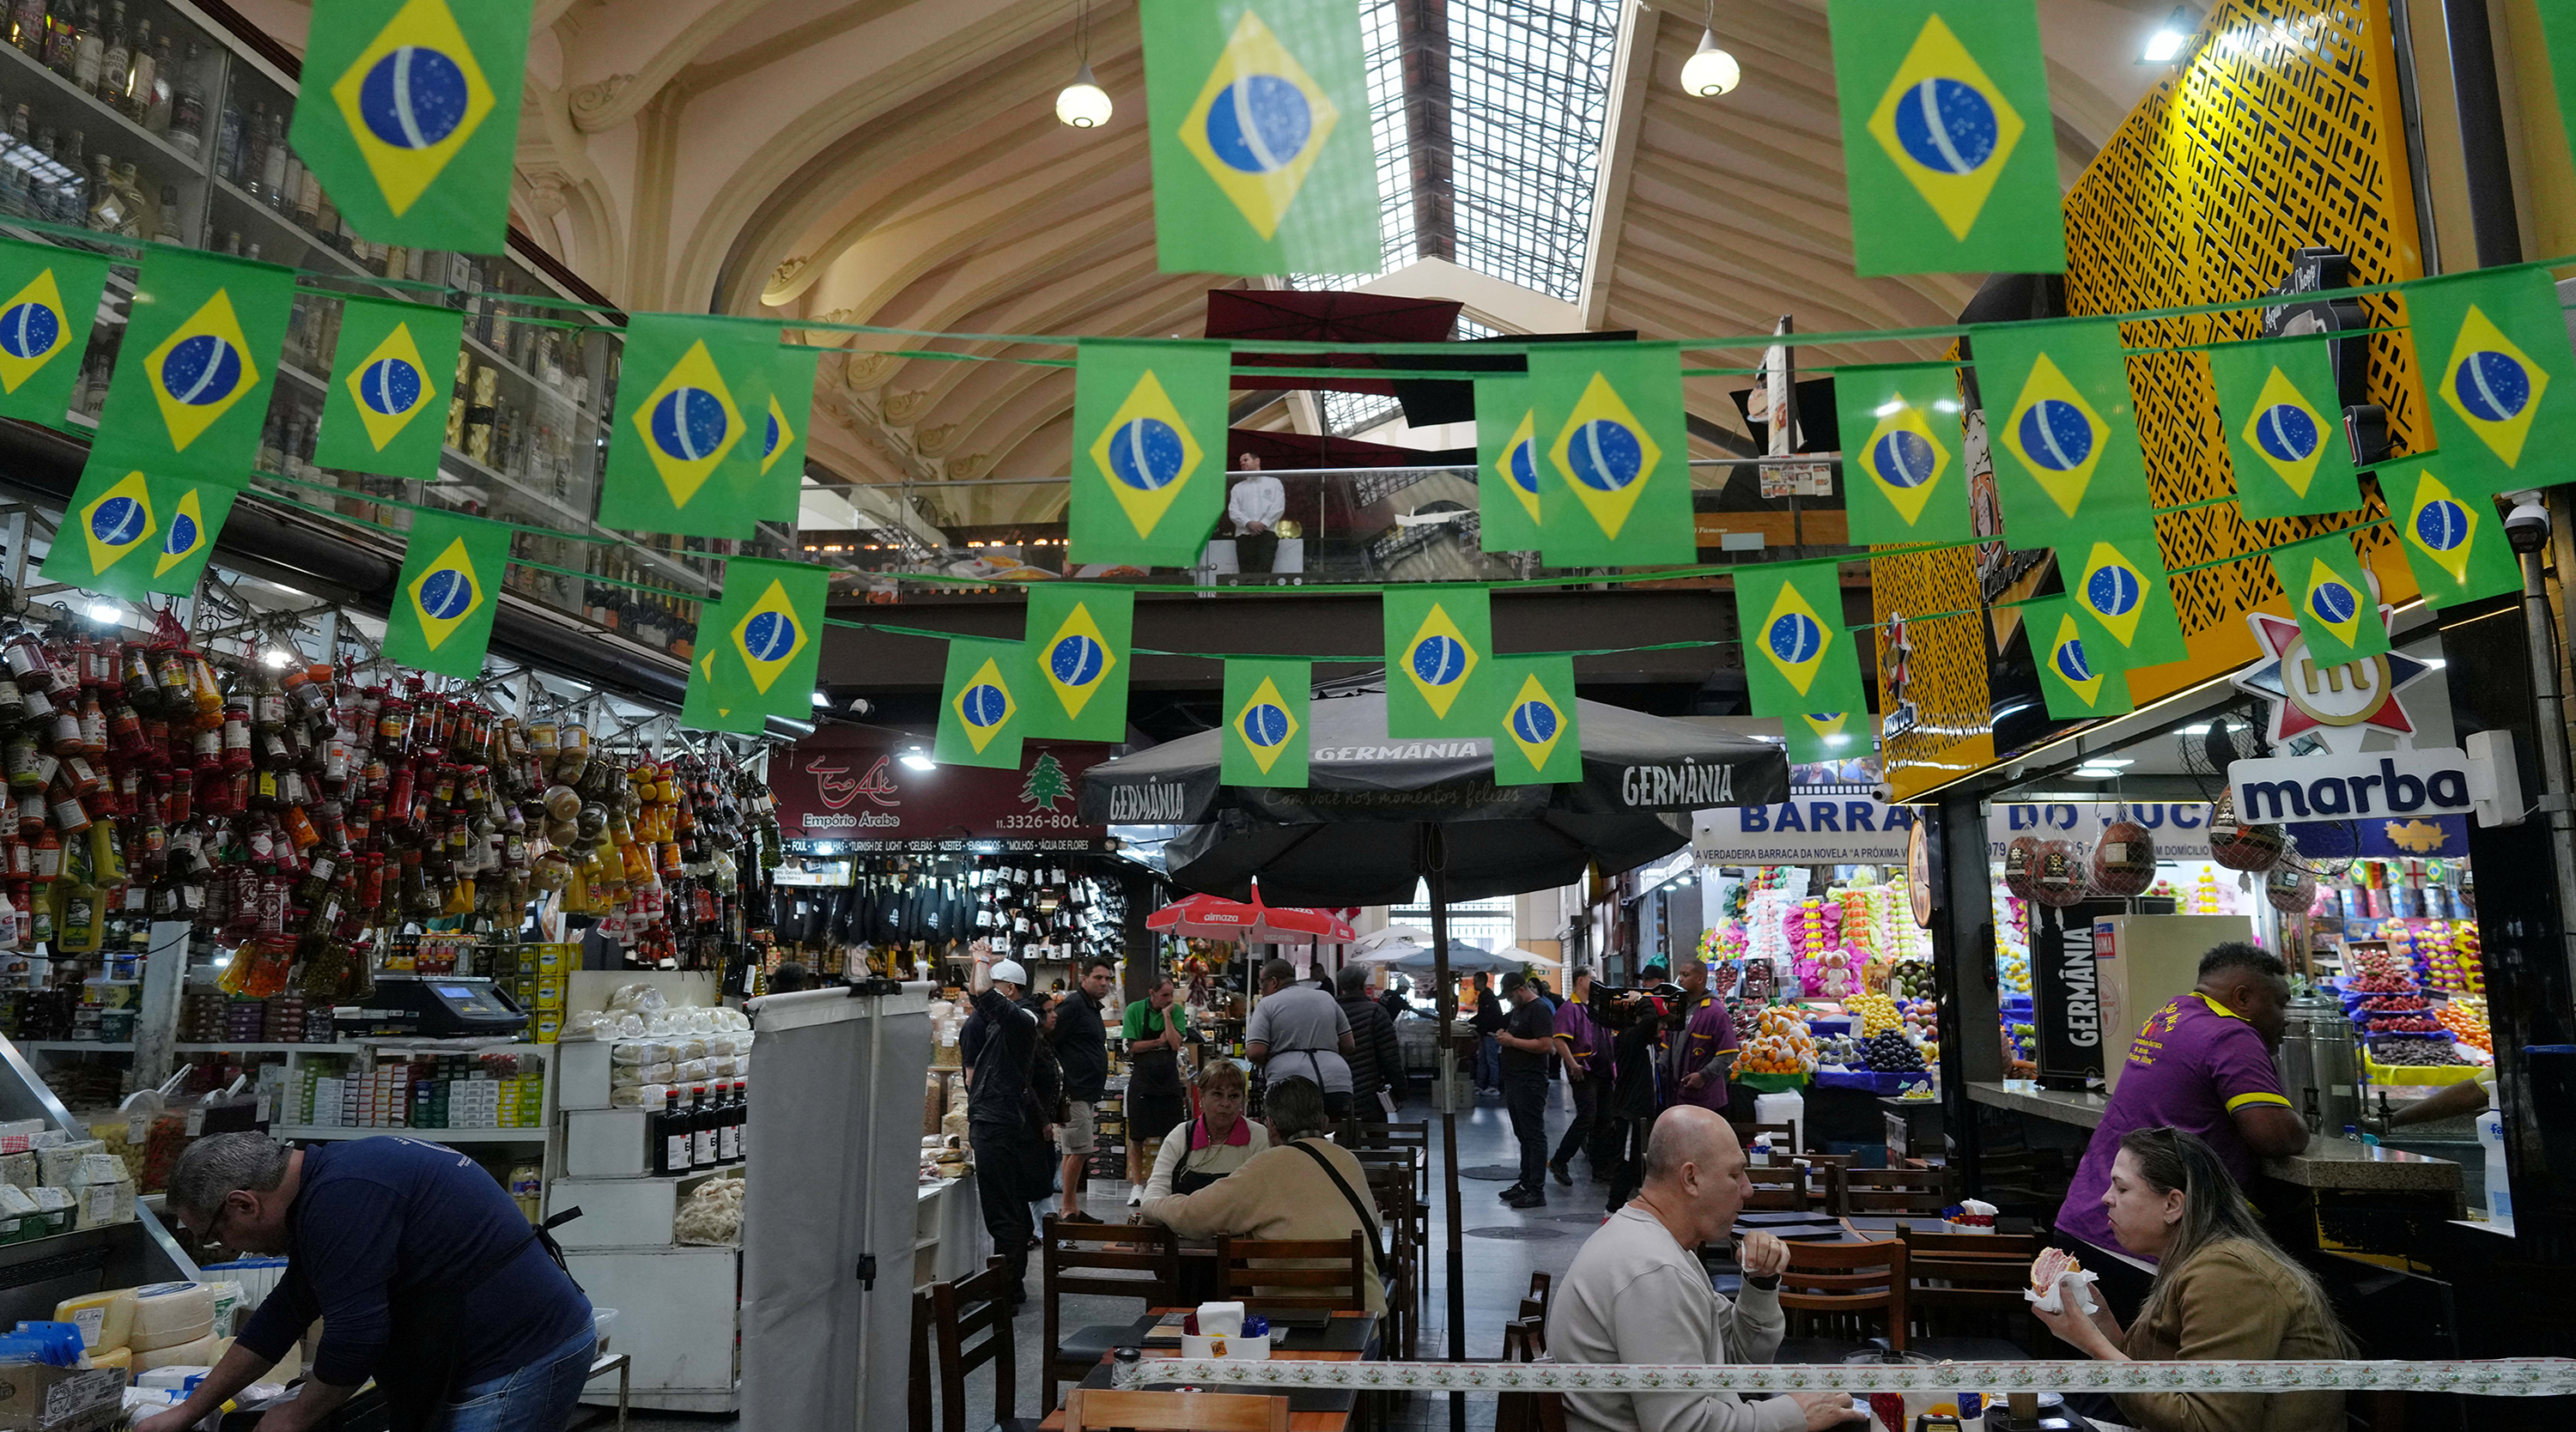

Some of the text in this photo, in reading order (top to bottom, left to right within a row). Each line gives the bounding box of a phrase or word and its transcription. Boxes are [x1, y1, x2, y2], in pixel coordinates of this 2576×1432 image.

[1315, 742, 1479, 761] GERMÂNIA
[1623, 756, 1735, 805] GERMÂNIA
[2243, 758, 2470, 820] marba
[1110, 775, 1184, 821] GERMÂNIA
[803, 810, 900, 828] Empório Árabe
[996, 815, 1090, 828] 11.3326-806
[1741, 801, 1925, 832] BARRA
[2102, 804, 2215, 830] JUC
[885, 841, 902, 851] LIGHT
[1067, 840, 1089, 850] FLORES
[1696, 850, 1701, 859] A
[1703, 849, 1756, 859] VERDADEIRA
[1759, 849, 1799, 859] BARRACA
[1801, 849, 1813, 859] DA
[1814, 848, 1848, 858] NOVELA
[1862, 846, 1899, 858] PRÓXIMA
[2165, 844, 2209, 856] DOMÍCILIO
[1204, 913, 1238, 922] almaza
[2058, 926, 2099, 1047] GERMÂNIA
